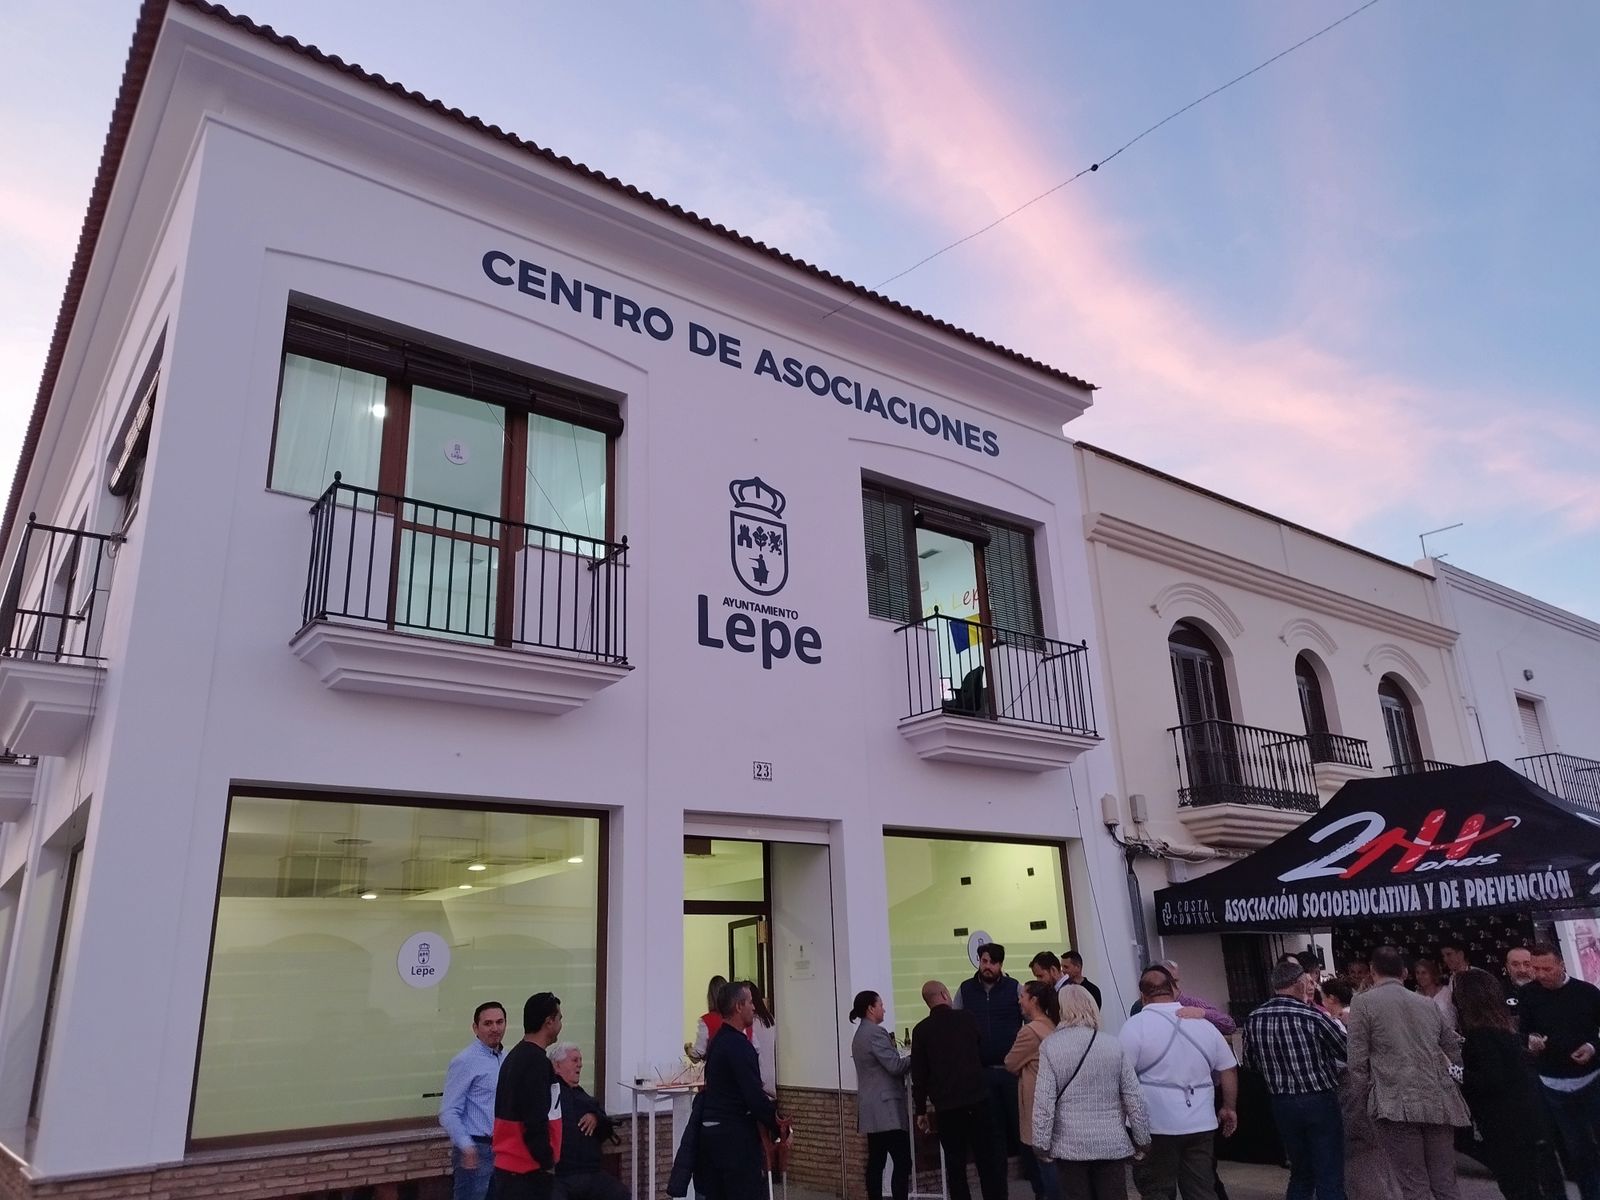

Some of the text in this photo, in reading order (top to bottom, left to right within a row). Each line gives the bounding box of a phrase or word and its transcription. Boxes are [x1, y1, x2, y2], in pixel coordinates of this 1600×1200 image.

[481, 250, 1000, 457] CENTRO DE ASOCIACIONES
[722, 596, 799, 620] AYUNTAMIENTO
[697, 594, 822, 670] Lepe
[756, 763, 770, 778] 23
[1225, 888, 1298, 922] ASOCIACIÓN
[1302, 884, 1421, 918] SOCIOEDUCATIVA
[1424, 882, 1434, 910] Y
[1439, 880, 1461, 909] DE
[1464, 865, 1574, 907] PREVENCIÓN
[1177, 900, 1209, 912] COSTA
[1172, 911, 1218, 925] CONTROL
[411, 966, 435, 977] Lepe
